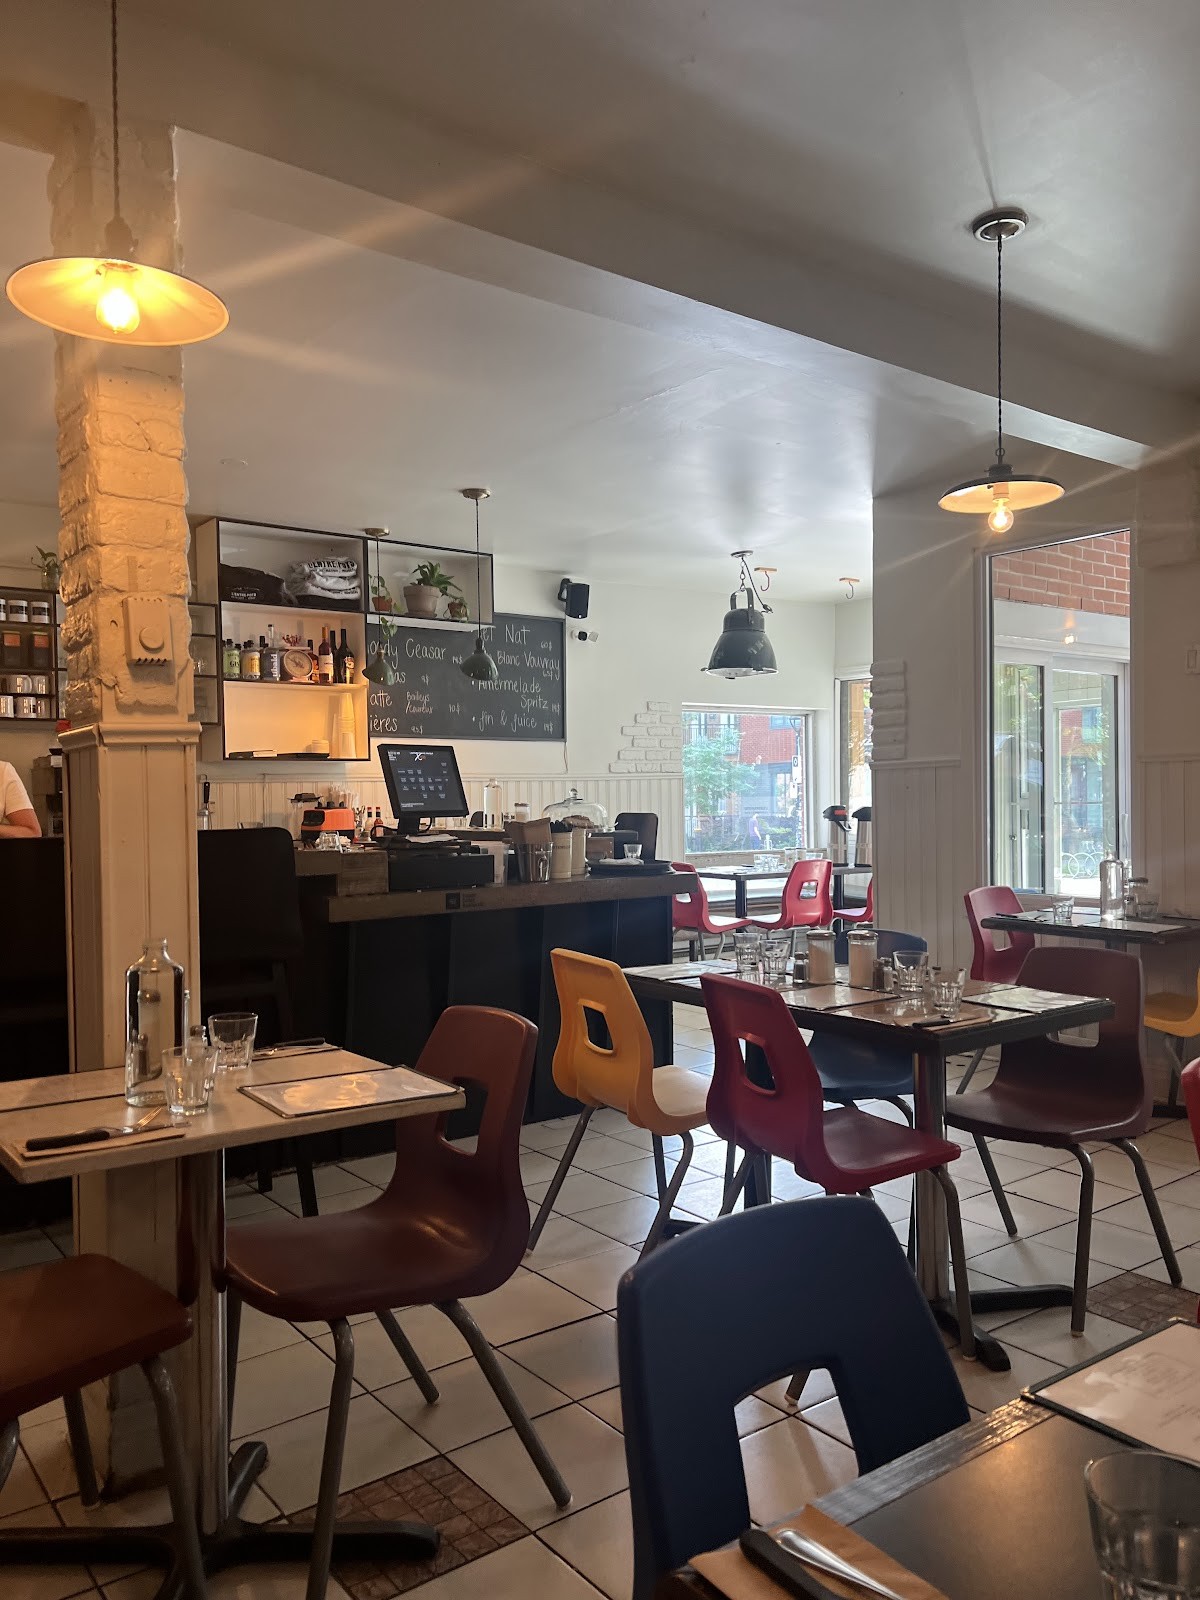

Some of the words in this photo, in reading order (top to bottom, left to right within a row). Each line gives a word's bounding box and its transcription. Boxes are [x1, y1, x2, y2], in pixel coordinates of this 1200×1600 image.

[505, 623, 531, 645] Nat
[405, 638, 447, 660] Ceasar
[497, 650, 521, 667] Blanc
[523, 650, 560, 681] Vouvray
[520, 694, 549, 713] Spritz
[500, 709, 508, 726] &
